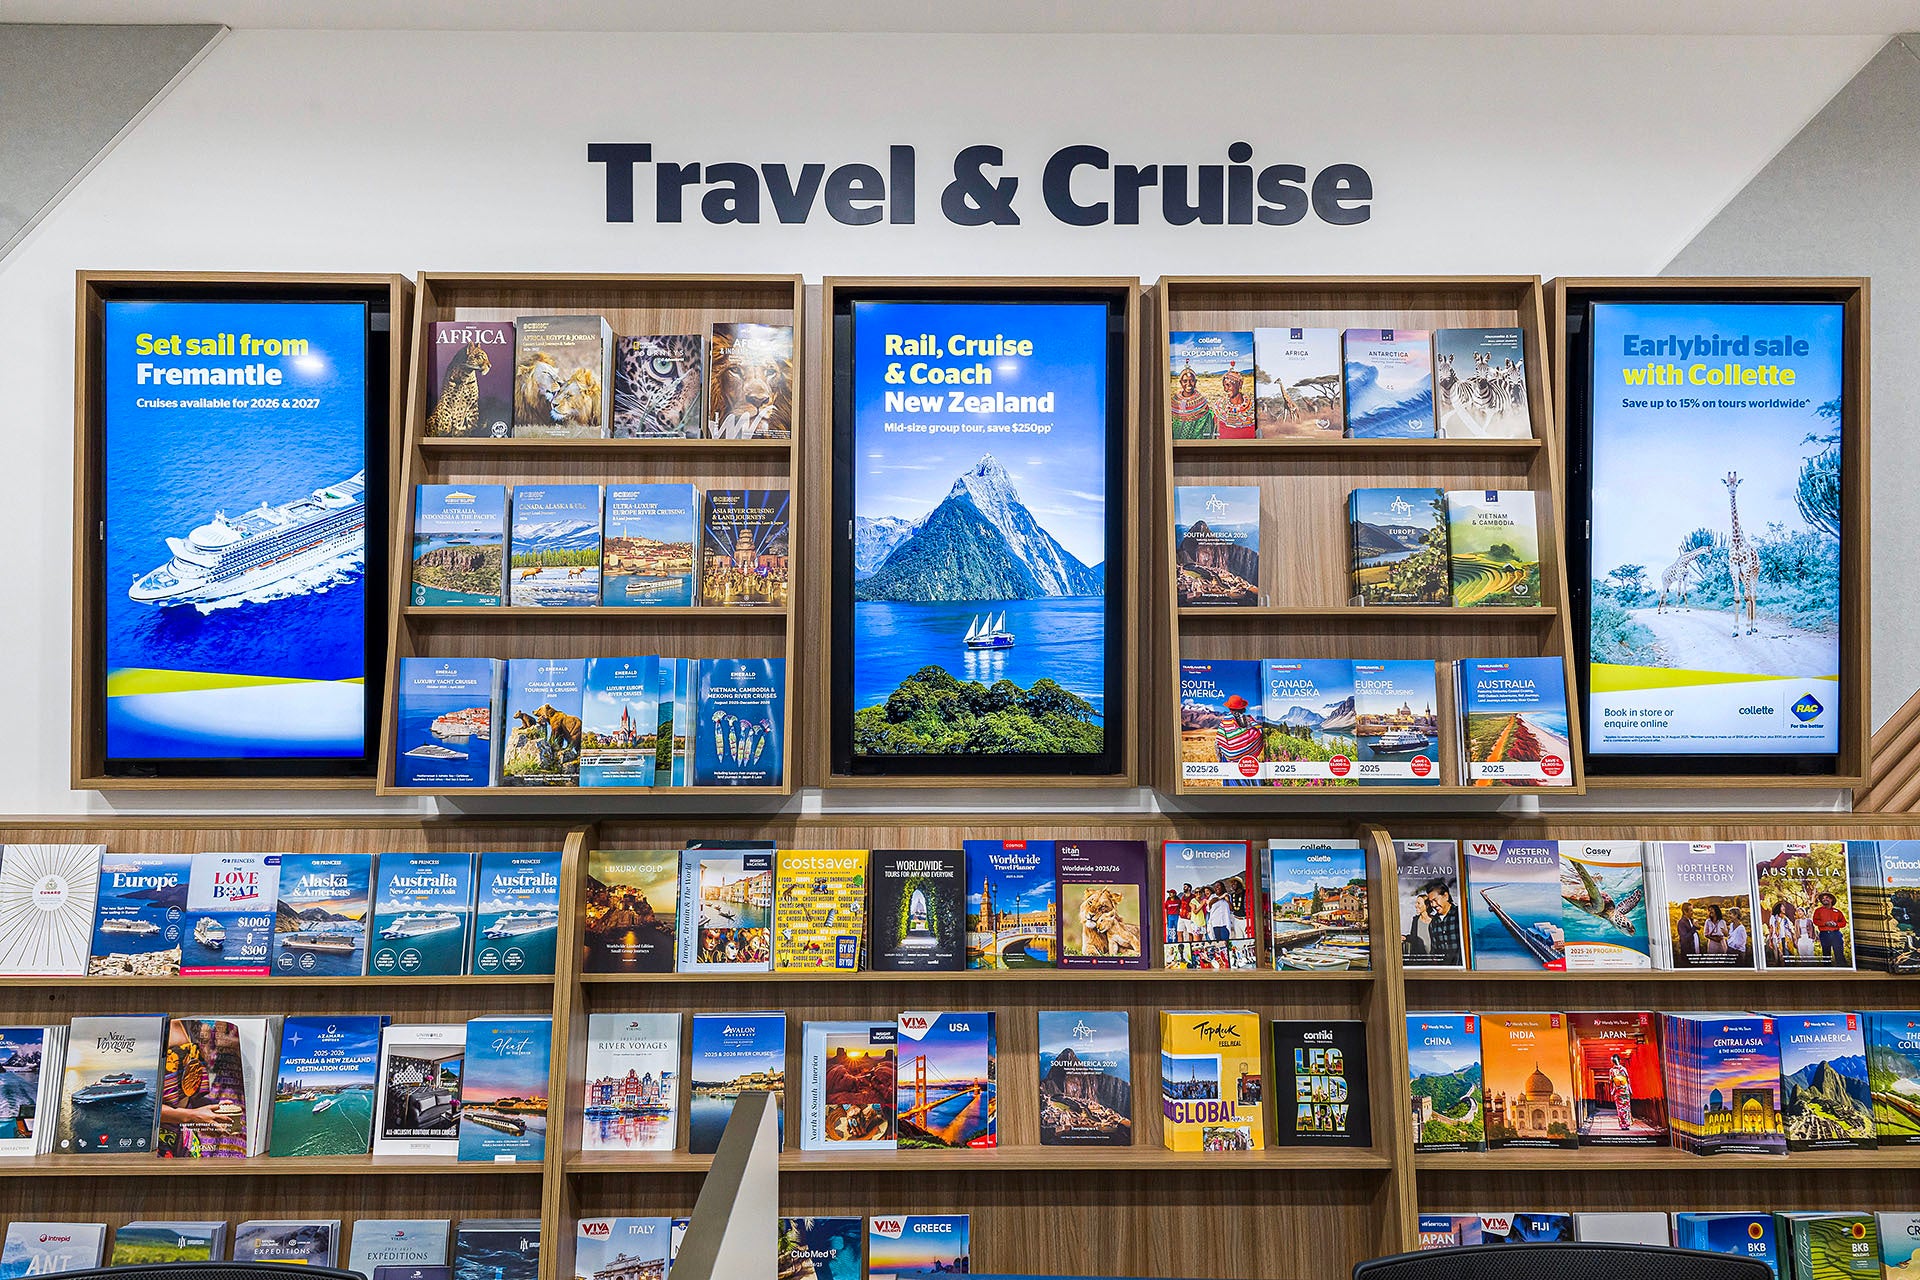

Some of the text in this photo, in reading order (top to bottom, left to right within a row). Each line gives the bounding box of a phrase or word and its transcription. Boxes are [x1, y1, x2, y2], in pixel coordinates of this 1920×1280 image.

[588, 141, 1373, 227] Travel & Cruise
[436, 330, 506, 344] AFRICA
[136, 333, 308, 356] Set sail from
[885, 334, 1033, 359] Rail, Cruise
[1623, 334, 1809, 360] Earlybird sale
[137, 363, 282, 386] Fremantle
[884, 363, 992, 384] & Coach
[1623, 363, 1796, 385] with Collette
[136, 398, 320, 408] Cruises available for 2026 & 2027
[885, 391, 1054, 413] New Zealand
[1622, 399, 1649, 408] Save
[1650, 401, 1664, 410] up
[1666, 400, 1677, 408] to
[1679, 399, 1700, 408] 15%
[1718, 400, 1746, 408] tours
[1749, 398, 1810, 408] worldwide^
[884, 423, 927, 432] Mid-size
[929, 425, 959, 434] group
[961, 424, 985, 434] tour,
[1182, 680, 1215, 688] SOUTH
[1271, 680, 1314, 689] CANADA
[1477, 680, 1535, 689] AUSTRALIA
[1604, 708, 1627, 717] Book
[1629, 709, 1637, 717] in
[1639, 709, 1662, 717] store
[1739, 706, 1774, 715] collette
[1796, 705, 1819, 713] RAC
[1604, 720, 1638, 729] enquire
[1275, 765, 1296, 773] 2025
[1360, 765, 1380, 773] 2025
[1482, 765, 1504, 773] 2025
[1195, 850, 1230, 860] Intrepid
[1507, 848, 1549, 856] WESTERN
[1586, 847, 1611, 857] Casey
[989, 854, 1041, 864] Worldwide
[1505, 856, 1554, 865] AUSTRALIA
[896, 861, 943, 871] WORLDWIDE
[1407, 866, 1453, 875] ZEALAND
[1677, 864, 1734, 873] NORTHERN
[1761, 867, 1841, 877] AUSTRALIA
[112, 872, 178, 891] Europe
[215, 872, 259, 884] LOVE
[297, 874, 348, 887] Alaska
[389, 874, 457, 887] Australia
[491, 873, 558, 887] Australia
[1677, 874, 1735, 882] TERRITORY
[389, 888, 404, 896] New
[441, 887, 456, 895] Asia
[241, 946, 267, 955] $300
[902, 1018, 928, 1029] VIVA
[949, 1023, 970, 1032] USA
[722, 1025, 755, 1034] AVALON
[1303, 1031, 1333, 1040] contiki
[1509, 1031, 1535, 1039] INDIA
[1599, 1031, 1627, 1039] JAPAN
[1790, 1034, 1852, 1043] LATIN AMERICA
[96, 1038, 135, 1053] Voyaging
[599, 1042, 626, 1050] RIVER
[1424, 1037, 1451, 1046] CHINA
[1713, 1038, 1763, 1047] CENTRAL ASIA
[1294, 1048, 1343, 1076] LEG
[296, 1065, 337, 1073] DESTINATION
[1295, 1076, 1349, 1102] END
[1295, 1103, 1349, 1131] ARY
[874, 1221, 901, 1233] VIVA
[1482, 1218, 1509, 1229] VIVA
[1532, 1221, 1550, 1231] FIJI
[582, 1223, 610, 1235] VIVA
[629, 1226, 655, 1234] ITALY
[914, 1224, 952, 1233] GREECE
[1748, 1243, 1766, 1252] BKB
[1852, 1243, 1869, 1252] BKB
[367, 1252, 428, 1260] EXPEDITIONS
[791, 1250, 829, 1258] Club Med
